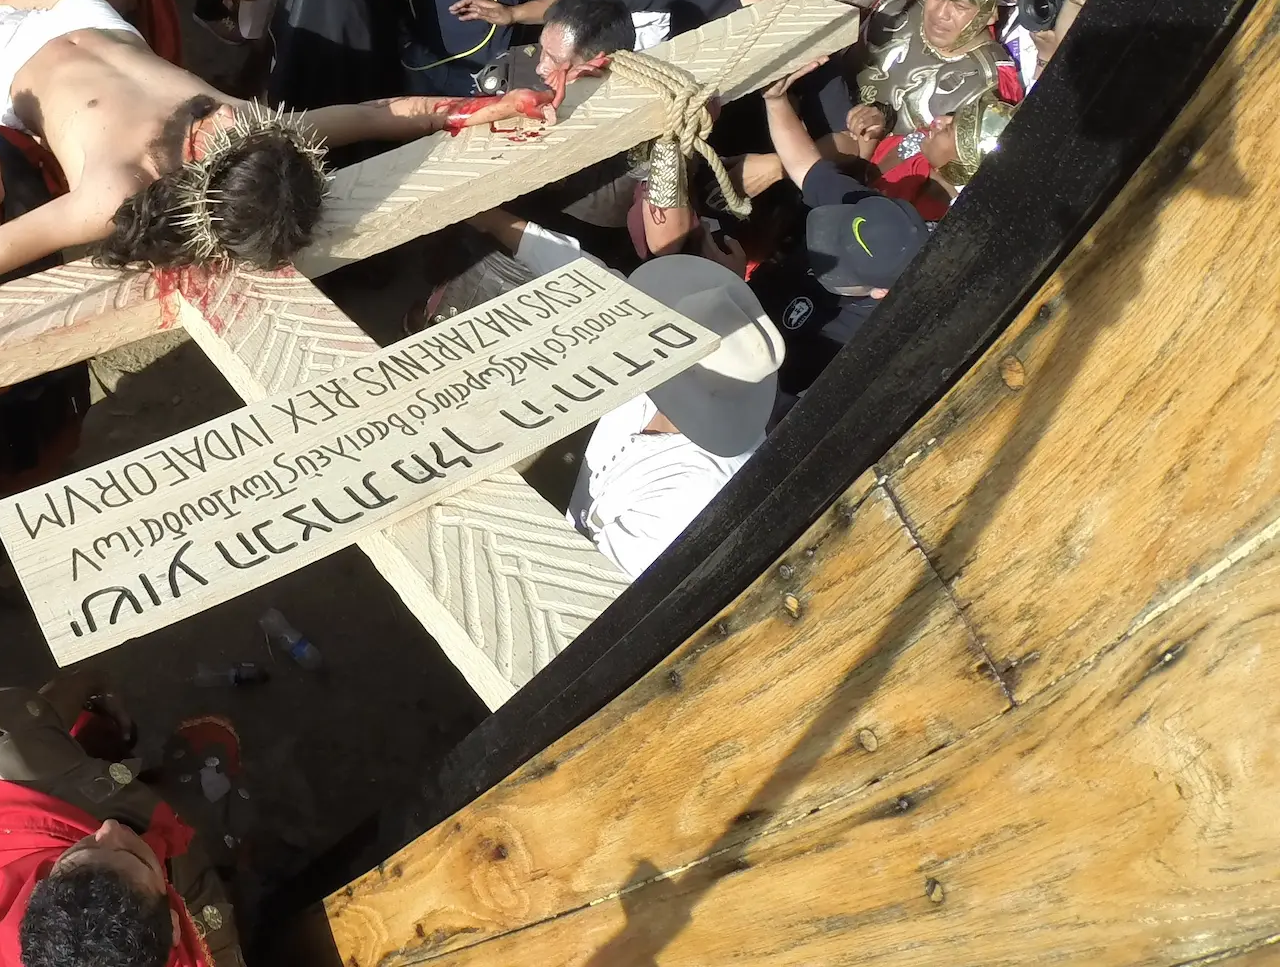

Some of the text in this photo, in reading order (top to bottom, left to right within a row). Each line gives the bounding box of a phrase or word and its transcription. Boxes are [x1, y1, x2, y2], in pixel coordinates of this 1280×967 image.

[13, 268, 606, 540] IESVS NAZARENVS REX IVDAEORVM
[68, 539, 209, 638] ישוע
[389, 425, 504, 485] מלך
[498, 321, 698, 430] היהודים
